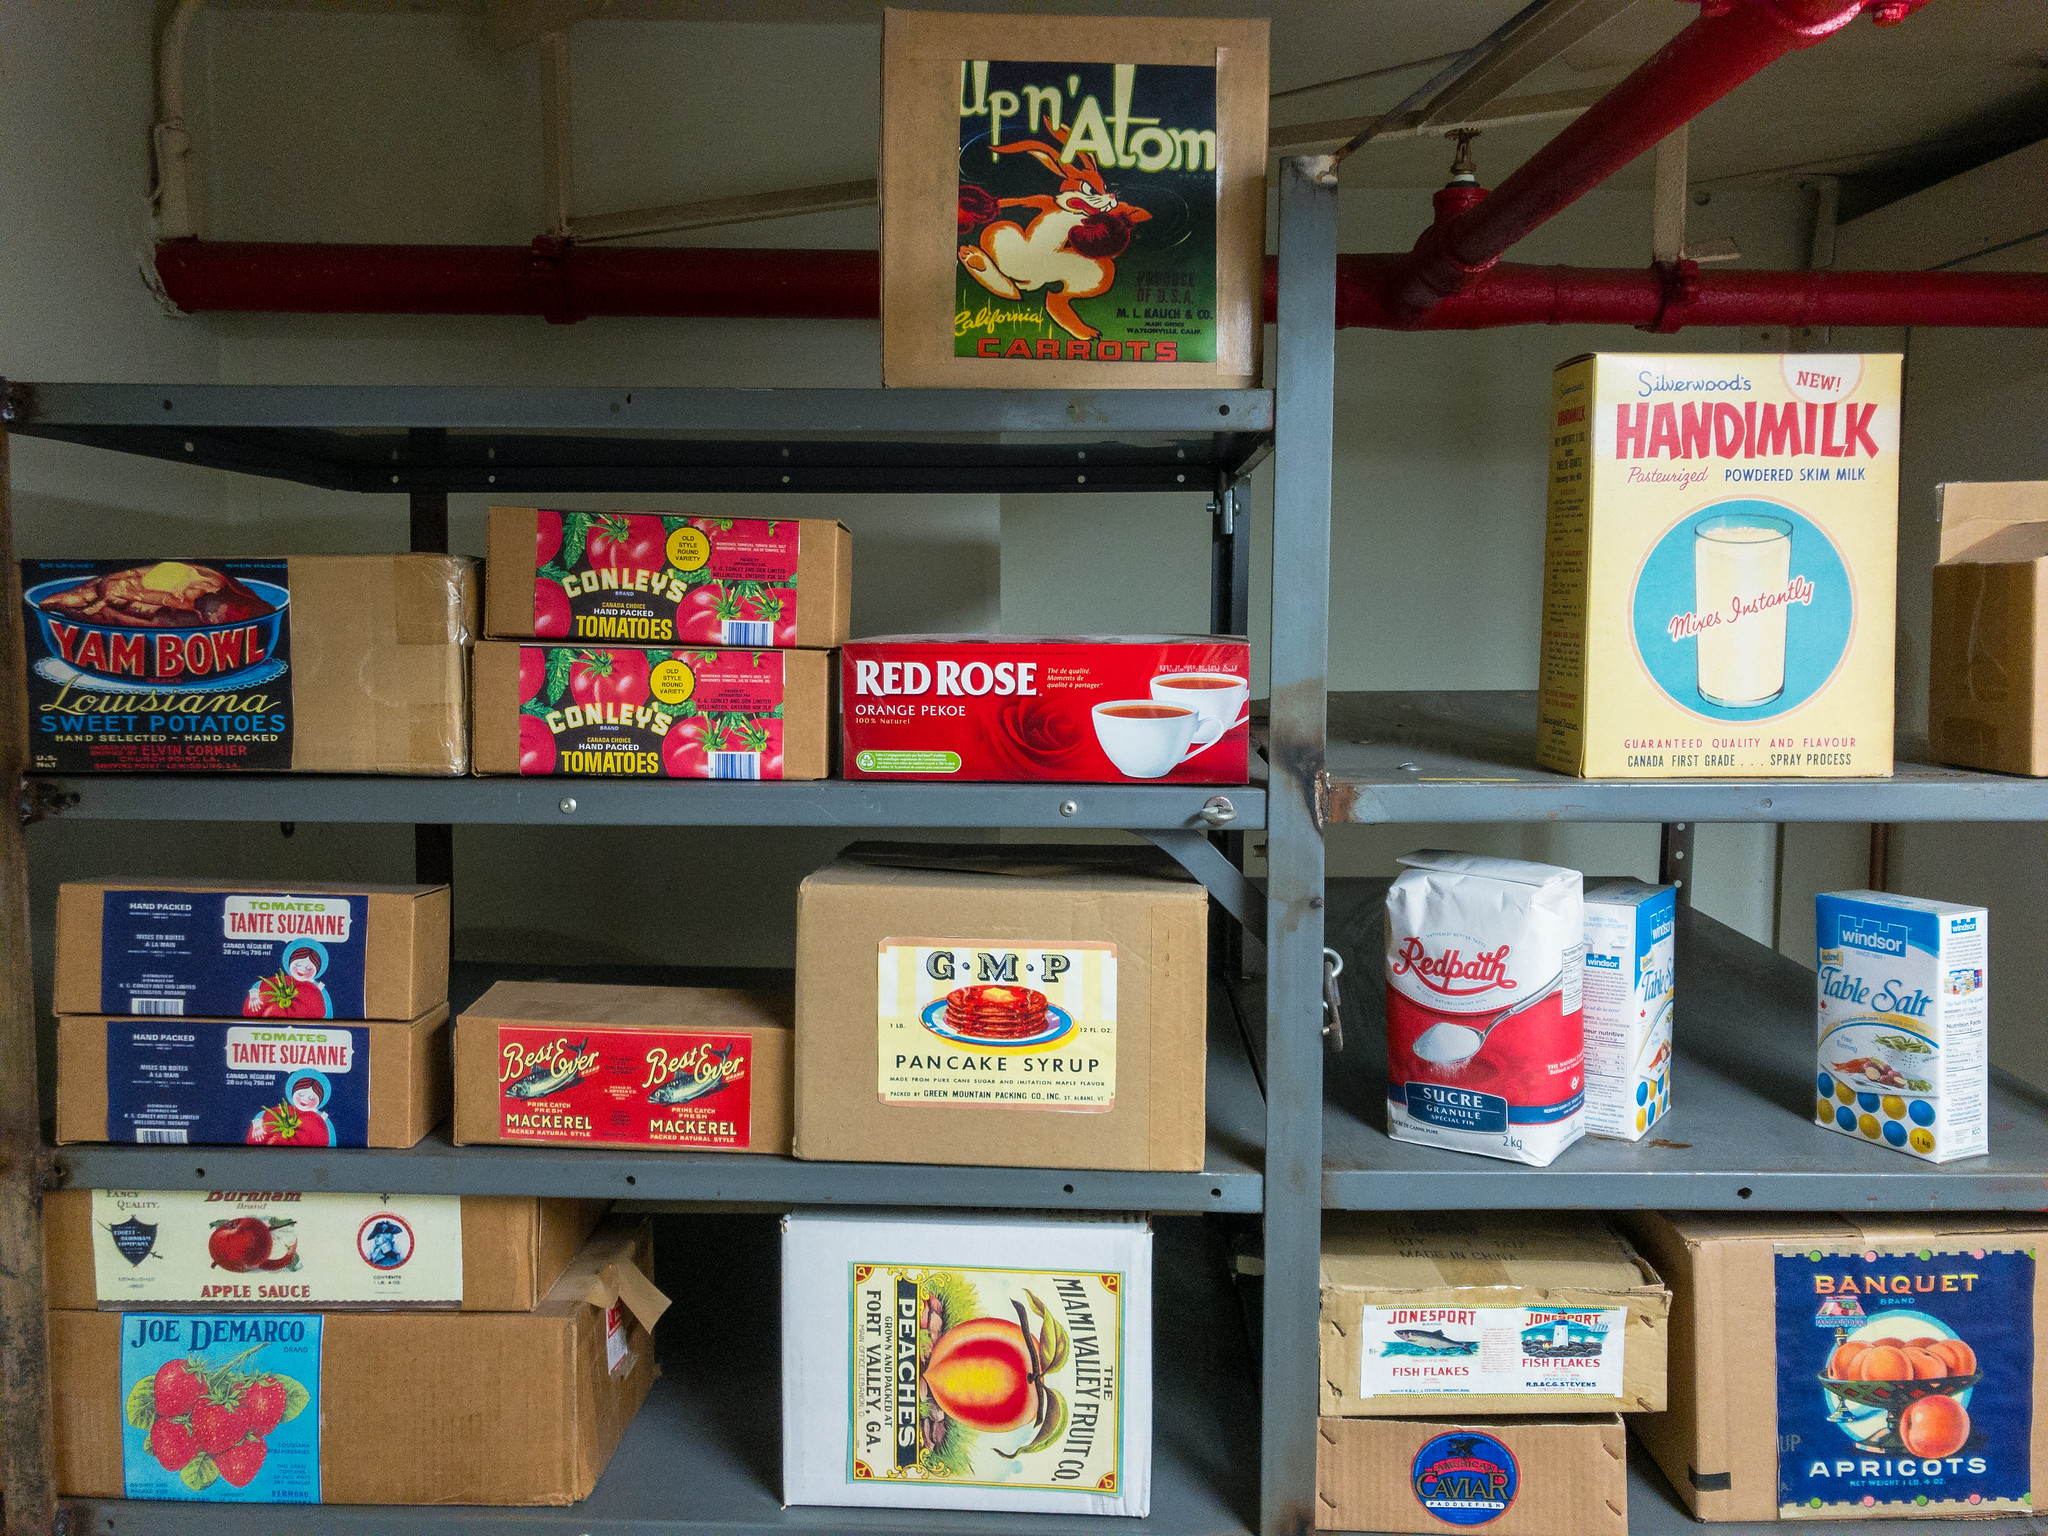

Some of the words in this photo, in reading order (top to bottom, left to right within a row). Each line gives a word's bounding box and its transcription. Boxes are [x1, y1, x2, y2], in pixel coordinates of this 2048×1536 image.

[1059, 63, 1216, 173] Atom
[954, 304, 1044, 336] California
[976, 337, 1179, 363] CARROTS
[1638, 370, 1752, 397] Silverwood's
[1796, 370, 1841, 392] NEW!
[1615, 401, 1880, 461] HANDIMILK
[1627, 466, 1709, 490] Pasteurized
[1725, 468, 1794, 482] POWDERED
[1799, 467, 1831, 482] SKIM
[1835, 467, 1866, 481] MILK
[677, 548, 700, 556] ROUND
[561, 567, 688, 604] CONLEY'S
[593, 608, 619, 616] HAND
[620, 609, 654, 618] PACKED
[1668, 610, 1722, 639] Mixes
[1727, 576, 1814, 623] Instantly
[576, 615, 673, 641] TOMATOES
[48, 618, 146, 677] YAM
[156, 625, 265, 677] BOWL
[856, 660, 932, 697] RED
[936, 660, 1038, 697] ROSE
[39, 673, 282, 716] Louisiana
[545, 701, 673, 736] CONLEY'S
[855, 704, 916, 716] ORANGE
[921, 705, 966, 717] PEKOE
[880, 717, 911, 725] Naturel
[40, 715, 139, 732] SWEET
[150, 714, 286, 732] POTATOES
[55, 734, 93, 742] HAND
[98, 734, 167, 742] SELECTED
[184, 734, 223, 742] HAND
[226, 734, 279, 742] PACKED
[605, 743, 640, 751] PACKED
[1624, 738, 1704, 749] GUARANTEED
[1711, 738, 1761, 749] QUALITY
[1769, 738, 1794, 748] AND
[1803, 737, 1857, 748] FLAVOUR
[142, 745, 182, 756] ELVIN
[186, 745, 248, 756] CORMIER
[1627, 755, 1664, 768] CANADA
[1671, 755, 1699, 767] FIRST
[1704, 754, 1736, 767] GRADE
[1770, 753, 1802, 767] SPRAY
[1806, 753, 1852, 766] PROCESS
[561, 750, 659, 774] TOMATOES
[157, 903, 192, 911] PACKED
[249, 901, 326, 912] TOMATES
[230, 912, 274, 933] TANTE
[277, 913, 345, 936] SUZANNE
[1952, 923, 1976, 932] windsor
[1842, 927, 1903, 952] windsor
[1393, 936, 1518, 996] Redpath
[1587, 958, 1619, 968] windsor
[1821, 966, 1870, 1005] Table
[1871, 979, 1934, 1017] Salt
[251, 1032, 328, 1043] TOMATES
[232, 1043, 276, 1064] TANTE
[279, 1044, 347, 1066] SUZANNE
[499, 1041, 554, 1083] Best
[550, 1038, 600, 1078] Ever
[896, 1055, 1007, 1071] PANCAKE
[1024, 1058, 1099, 1073] SYRUP
[642, 1047, 698, 1088] Best
[694, 1043, 744, 1084] Ever
[952, 1090, 991, 1098] MOUNTAIN
[995, 1091, 1027, 1099] PACKING
[1423, 1087, 1483, 1108] SUCRE
[506, 1113, 593, 1130] MACKEREL
[1426, 1104, 1481, 1120] GRANULÉ
[650, 1119, 738, 1136] MACKEREL
[1503, 1136, 1509, 1147] 2
[1510, 1136, 1523, 1150] kg
[1922, 1138, 1931, 1149] kg
[116, 1200, 160, 1211] QUALITY.
[236, 1202, 268, 1210] Brand
[1399, 1250, 1445, 1259] MADE
[1449, 1251, 1467, 1259] IN
[1471, 1252, 1518, 1261] CHINA
[200, 1285, 251, 1298] APPLE
[258, 1285, 311, 1298] SAUCE
[1814, 1274, 1979, 1295] BANQUET
[1052, 1277, 1096, 1333] MIAMI
[1879, 1297, 1915, 1305] BRAND
[866, 1290, 882, 1336] FORT
[1387, 1310, 1477, 1326] JONESPORT
[1525, 1313, 1601, 1327] JONESPORT
[131, 1319, 181, 1349] JOE
[187, 1320, 305, 1352] DEMARCO
[884, 1315, 893, 1350] GROWN
[283, 1346, 309, 1354] BRAND
[884, 1355, 893, 1373] AND
[898, 1298, 916, 1448] PEACHES
[1074, 1334, 1101, 1400] VALLEY
[1392, 1367, 1420, 1377] FISH
[1423, 1366, 1470, 1377] FLAKES
[1522, 1358, 1550, 1368] FISH
[1553, 1358, 1600, 1368] FLAKES
[865, 1344, 882, 1415] VALLEY,
[1103, 1365, 1113, 1401] THE
[884, 1376, 893, 1413] PACKED
[884, 1416, 893, 1428] AT
[1063, 1402, 1100, 1457] FRUIT
[865, 1421, 882, 1454] GA.
[1050, 1459, 1085, 1482] CO.
[1436, 1459, 1495, 1473] AMERICAN
[1809, 1457, 1987, 1478] APRICOTS
[1415, 1471, 1514, 1502] CAVIAR
